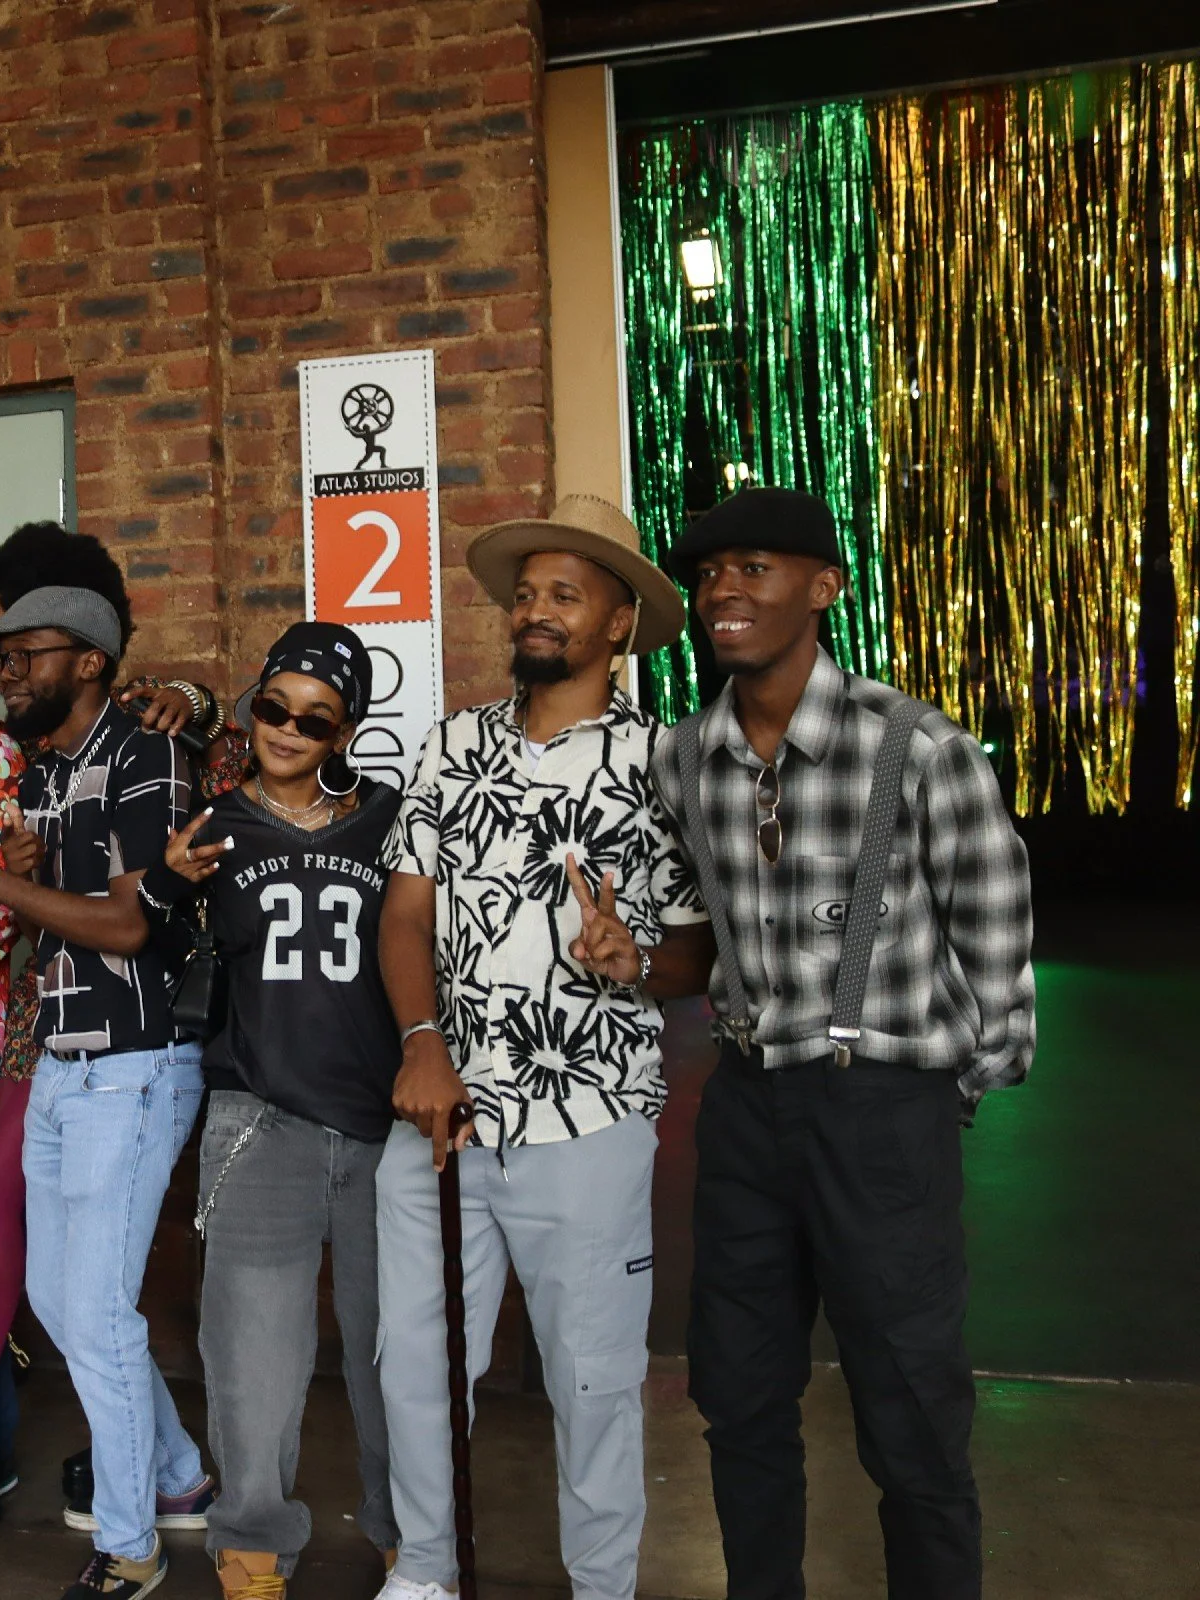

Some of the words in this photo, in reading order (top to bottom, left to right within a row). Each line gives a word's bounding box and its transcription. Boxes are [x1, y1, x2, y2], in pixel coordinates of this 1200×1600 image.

[319, 475, 359, 491] ATLAS
[364, 471, 420, 488] STUDIOS
[345, 509, 401, 609] 2
[234, 855, 290, 890] ENJOY
[303, 853, 385, 892] FREEDOM
[259, 882, 363, 982] 23
